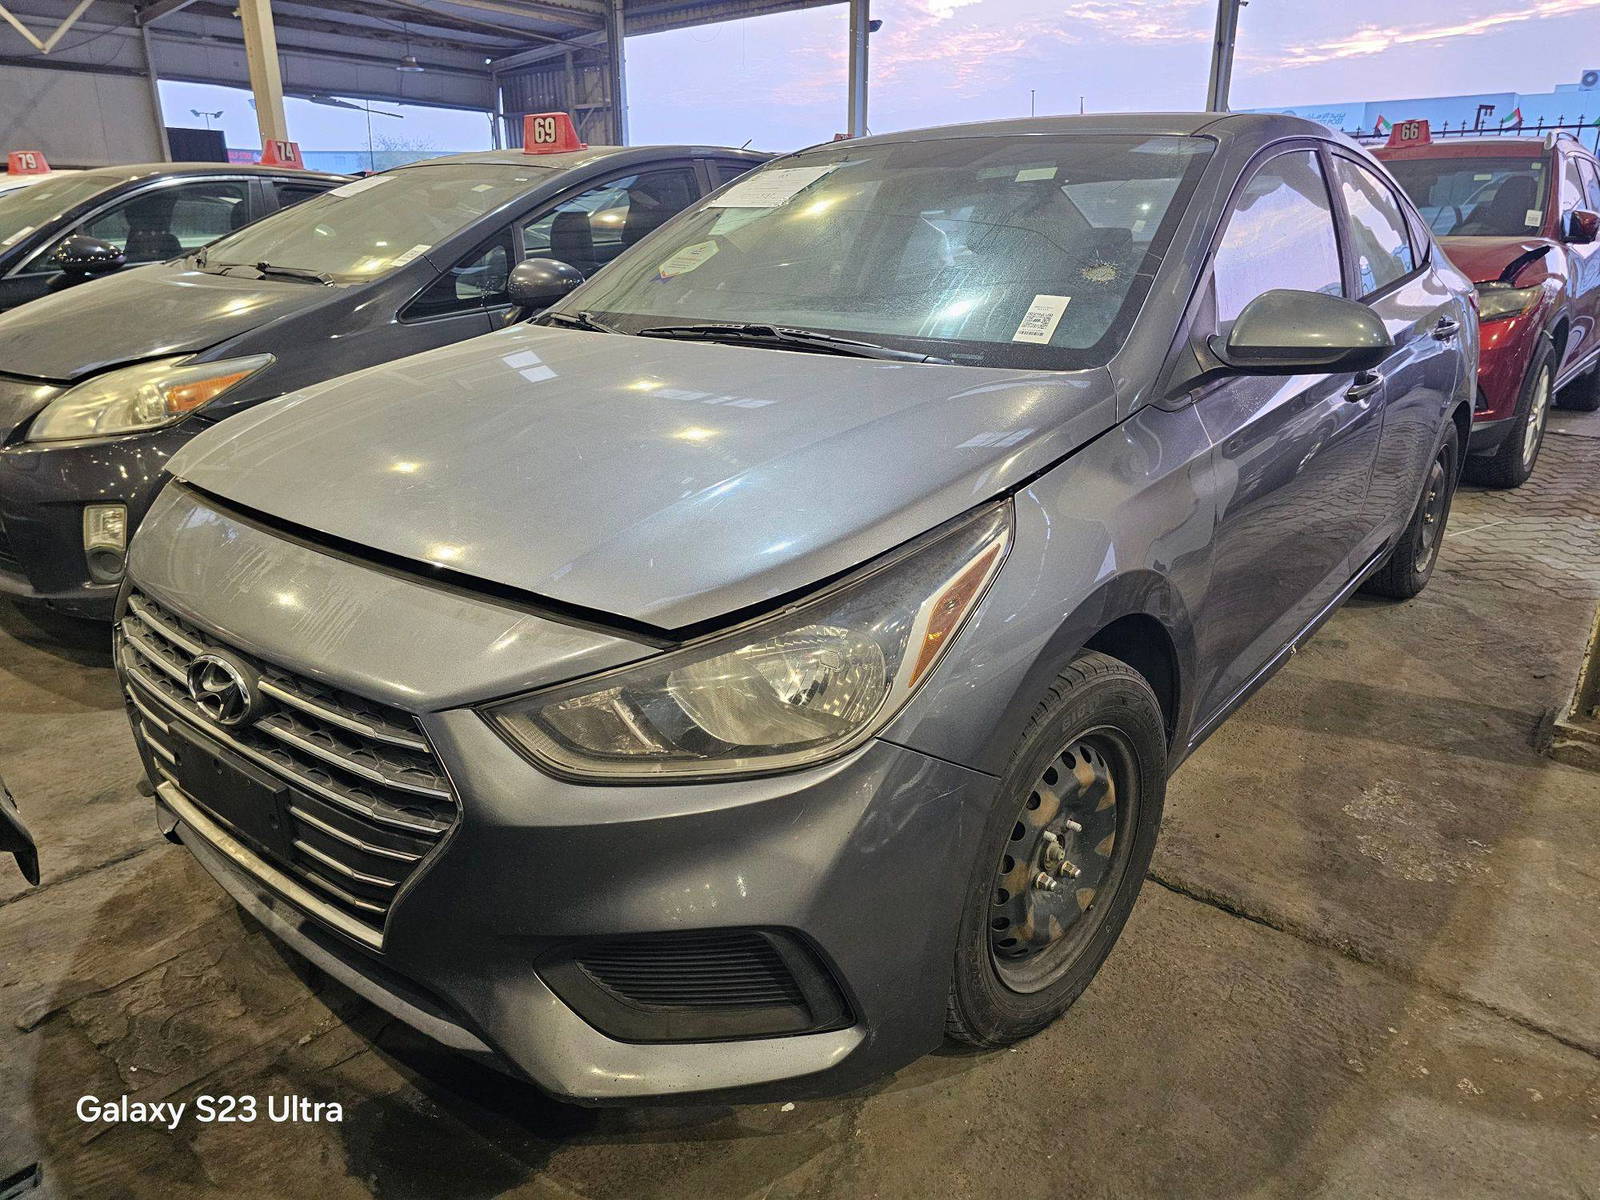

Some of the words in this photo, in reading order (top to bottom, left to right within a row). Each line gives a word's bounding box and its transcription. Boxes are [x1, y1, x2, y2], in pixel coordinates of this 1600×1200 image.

[534, 117, 556, 143] 69
[1401, 122, 1419, 140] 66
[277, 142, 295, 161] 74
[18, 153, 37, 169] 79
